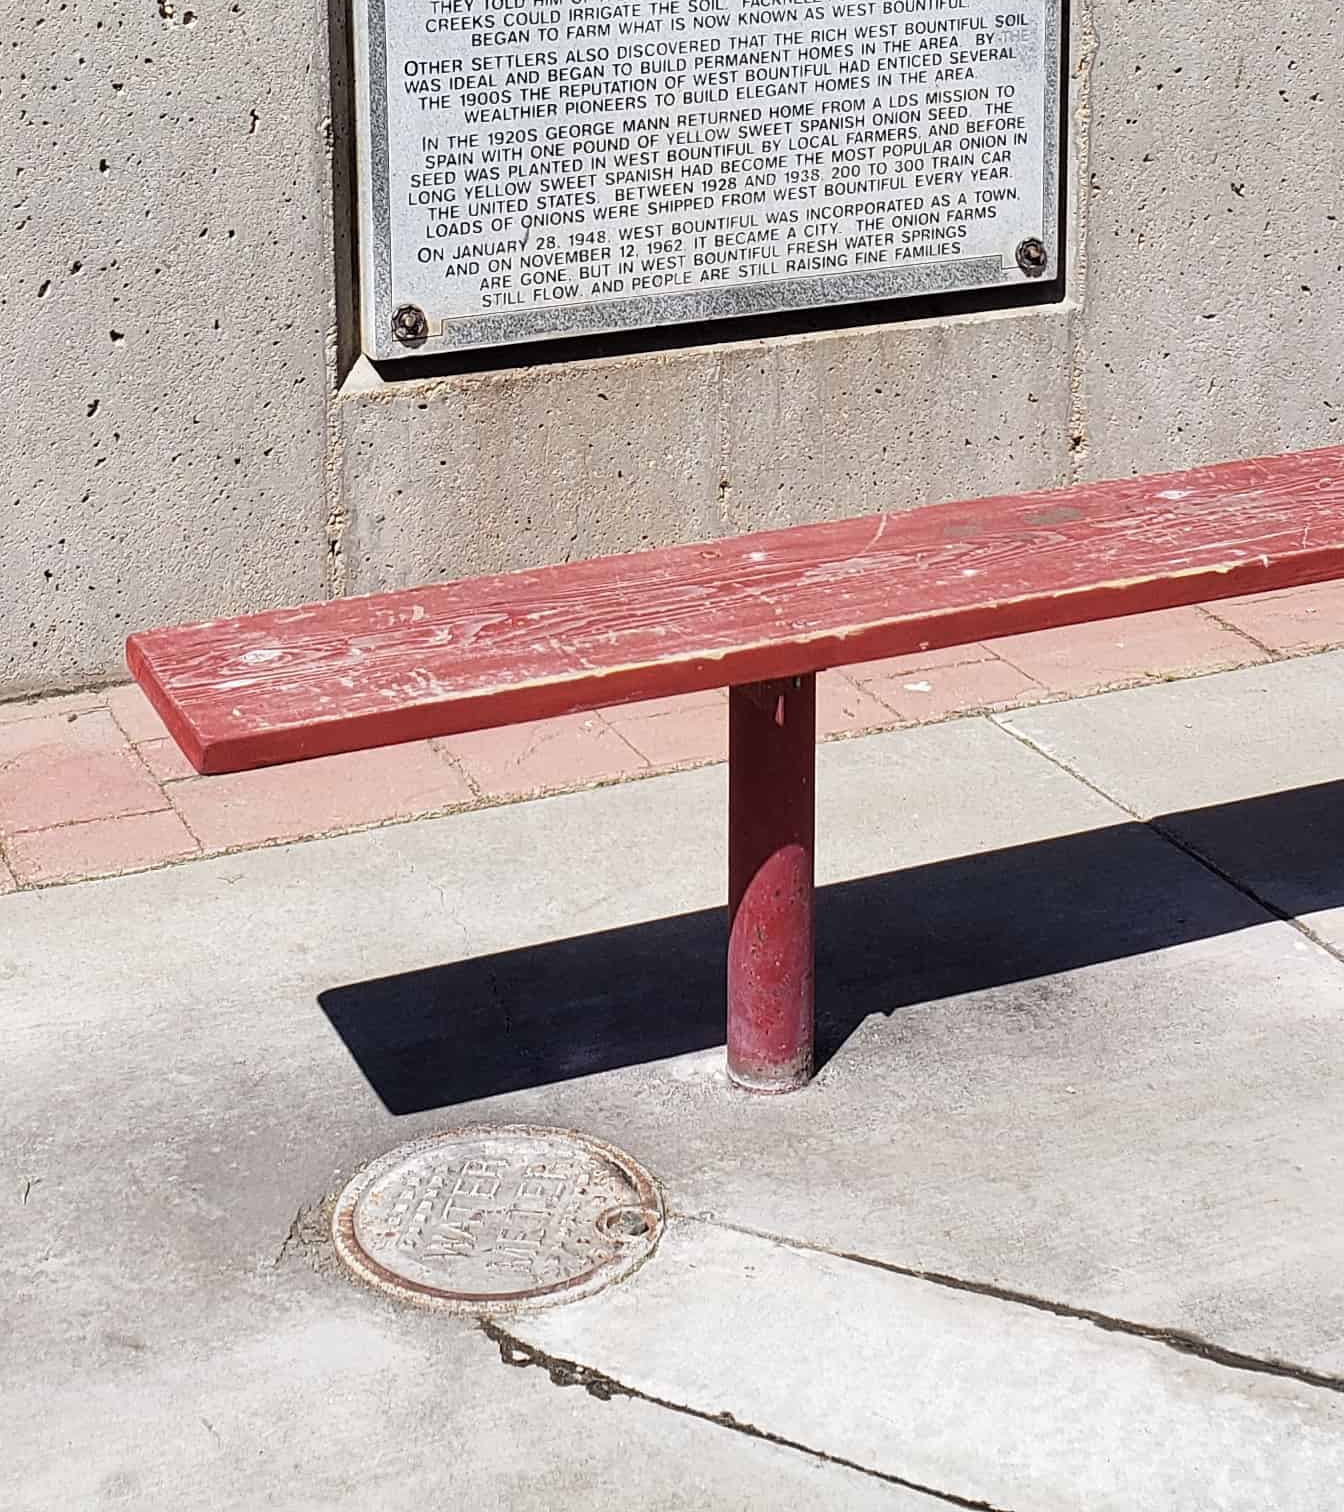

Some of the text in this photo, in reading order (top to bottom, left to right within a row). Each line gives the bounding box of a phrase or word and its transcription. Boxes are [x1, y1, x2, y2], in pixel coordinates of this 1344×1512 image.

[425, 14, 496, 33] CREEKS
[503, 9, 561, 28] COULD
[568, 3, 641, 22] IRRIGATE
[649, 0, 680, 16] THE
[471, 2, 876, 47] BEGAN TO FARM WHAT IS NOW KNOWN AS WEST
[471, 51, 558, 72] SETTLERS
[565, 47, 610, 64] ALSO
[616, 38, 721, 60] DISCOVERED
[728, 34, 767, 50] THAT
[774, 31, 803, 46] THE
[810, 28, 847, 43] RICH
[854, 23, 898, 39] WEST
[904, 16, 988, 36] BOUNTIFUL
[994, 13, 1029, 28] SOIL
[418, 47, 1017, 111] THE 1900S THE REPUTATION OF WEST BOUNTIFUL HAD ENTICED SEVERAL
[464, 70, 928, 124] WEALTHIER PIONEERS TO BUILD ELEGANT HOMES IN THE
[422, 84, 1015, 152] IN THE 1920S GEORGE MANN RETURNED HOME FROM A LDS MISSION TO
[425, 101, 1013, 170] SPAIN WITH ONE POUND OF YELLOW SWEET SPANISH ONION THE
[408, 132, 1028, 206] LONG YELLOW SWEET SPANISH HAD BECOME THE MOST POPULAR ONION IN
[410, 171, 456, 189] SEED
[464, 166, 500, 182] WAS
[508, 158, 583, 179] PLANTED
[591, 156, 606, 170] IN
[613, 150, 660, 168] WEST
[667, 142, 755, 163] BOUNTIFUL
[761, 139, 782, 153] BY
[788, 134, 839, 151] LOCAL
[928, 122, 960, 137] AND
[966, 116, 1025, 134] BEFORE
[426, 219, 483, 239] LOADS
[491, 216, 513, 232] OF
[520, 209, 585, 229] ONIONS
[592, 203, 639, 221] WERE
[647, 196, 715, 216] SHIPPED
[721, 190, 766, 207] FROM
[773, 185, 817, 201] WEST
[824, 176, 908, 197] BOUNTIFUL
[915, 171, 963, 188] EVERY
[482, 241, 961, 308] STILL AND PEOPLE ARE STILL RAISING FINE FAMILIES
